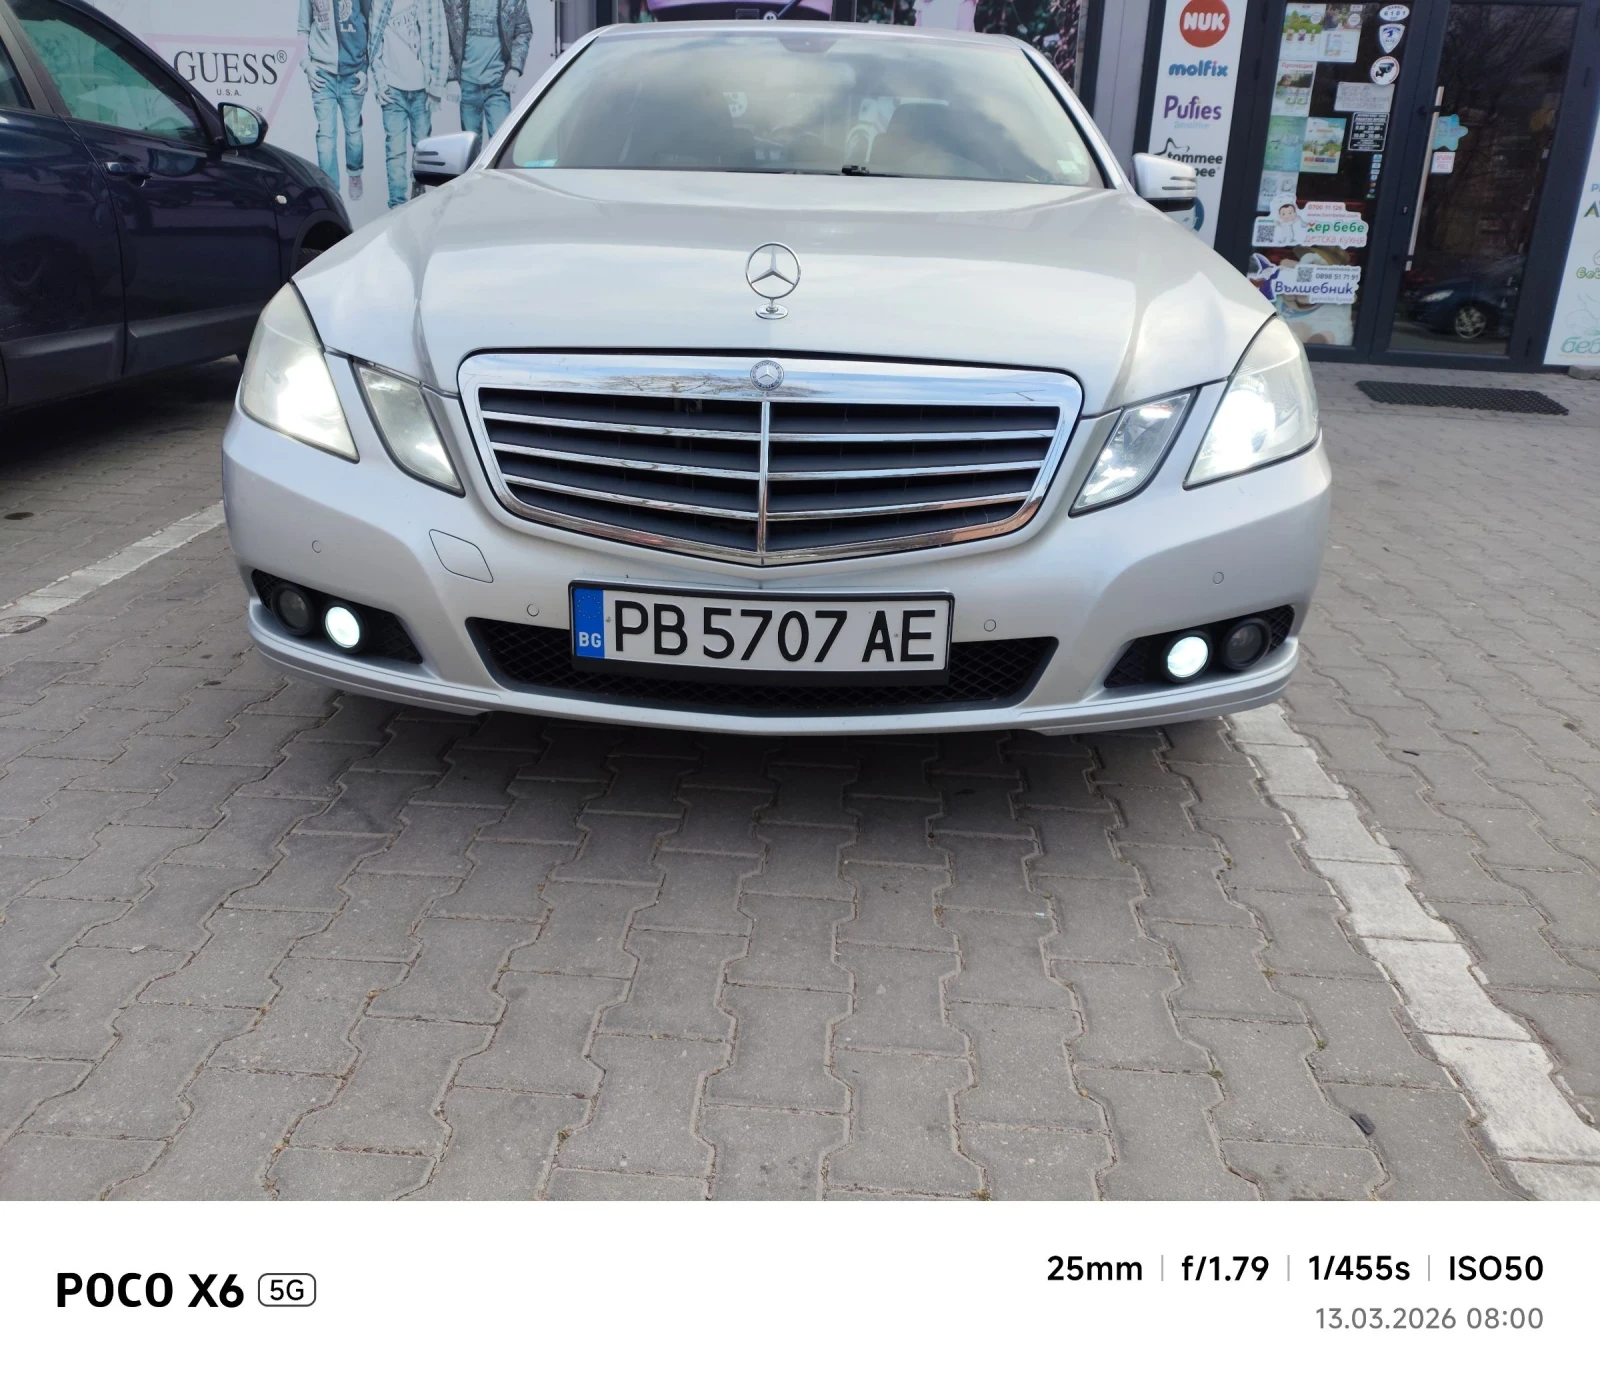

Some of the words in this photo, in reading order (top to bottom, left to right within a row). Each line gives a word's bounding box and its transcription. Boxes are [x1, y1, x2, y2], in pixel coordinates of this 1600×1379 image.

[1183, 12, 1226, 31] NUK
[1168, 60, 1229, 77] molfix
[1163, 95, 1222, 120] Pufies
[1333, 221, 1364, 232] бебе
[1315, 272, 1333, 280] 0898
[1274, 281, 1353, 294] Вълшебник
[578, 631, 602, 648] BG
[614, 600, 688, 656] PB
[703, 606, 847, 663] 5707
[861, 609, 936, 663] AE
